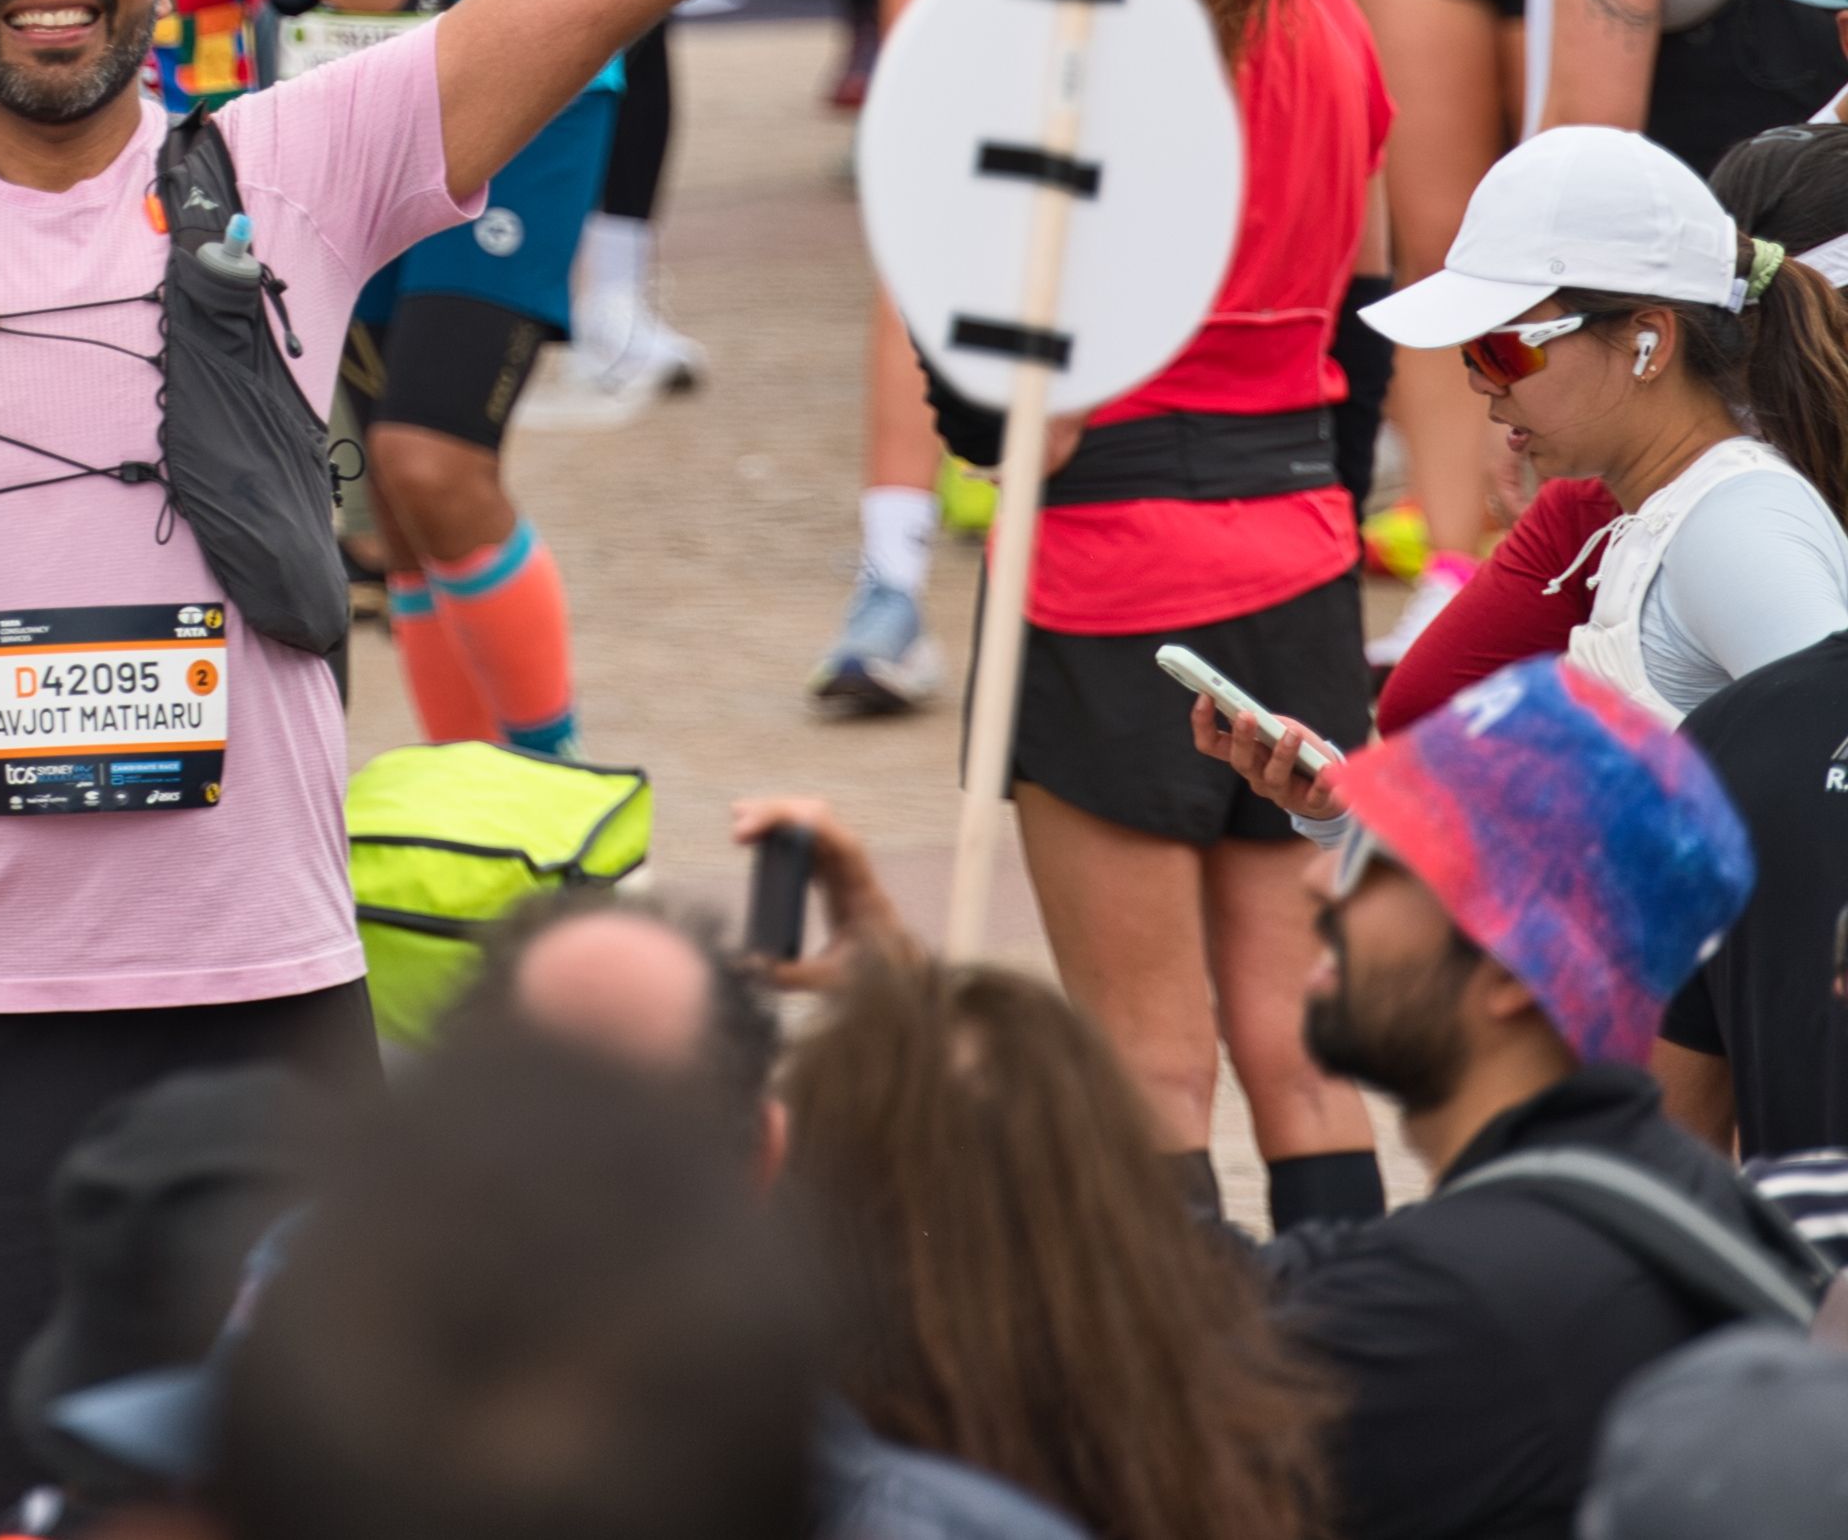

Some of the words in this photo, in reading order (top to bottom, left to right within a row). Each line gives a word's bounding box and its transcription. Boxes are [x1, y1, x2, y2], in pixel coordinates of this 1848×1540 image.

[173, 626, 208, 638] TATA
[14, 661, 161, 699] D42095
[196, 668, 209, 688] 2
[80, 702, 203, 733] MATHARU
[5, 763, 37, 785] tcs
